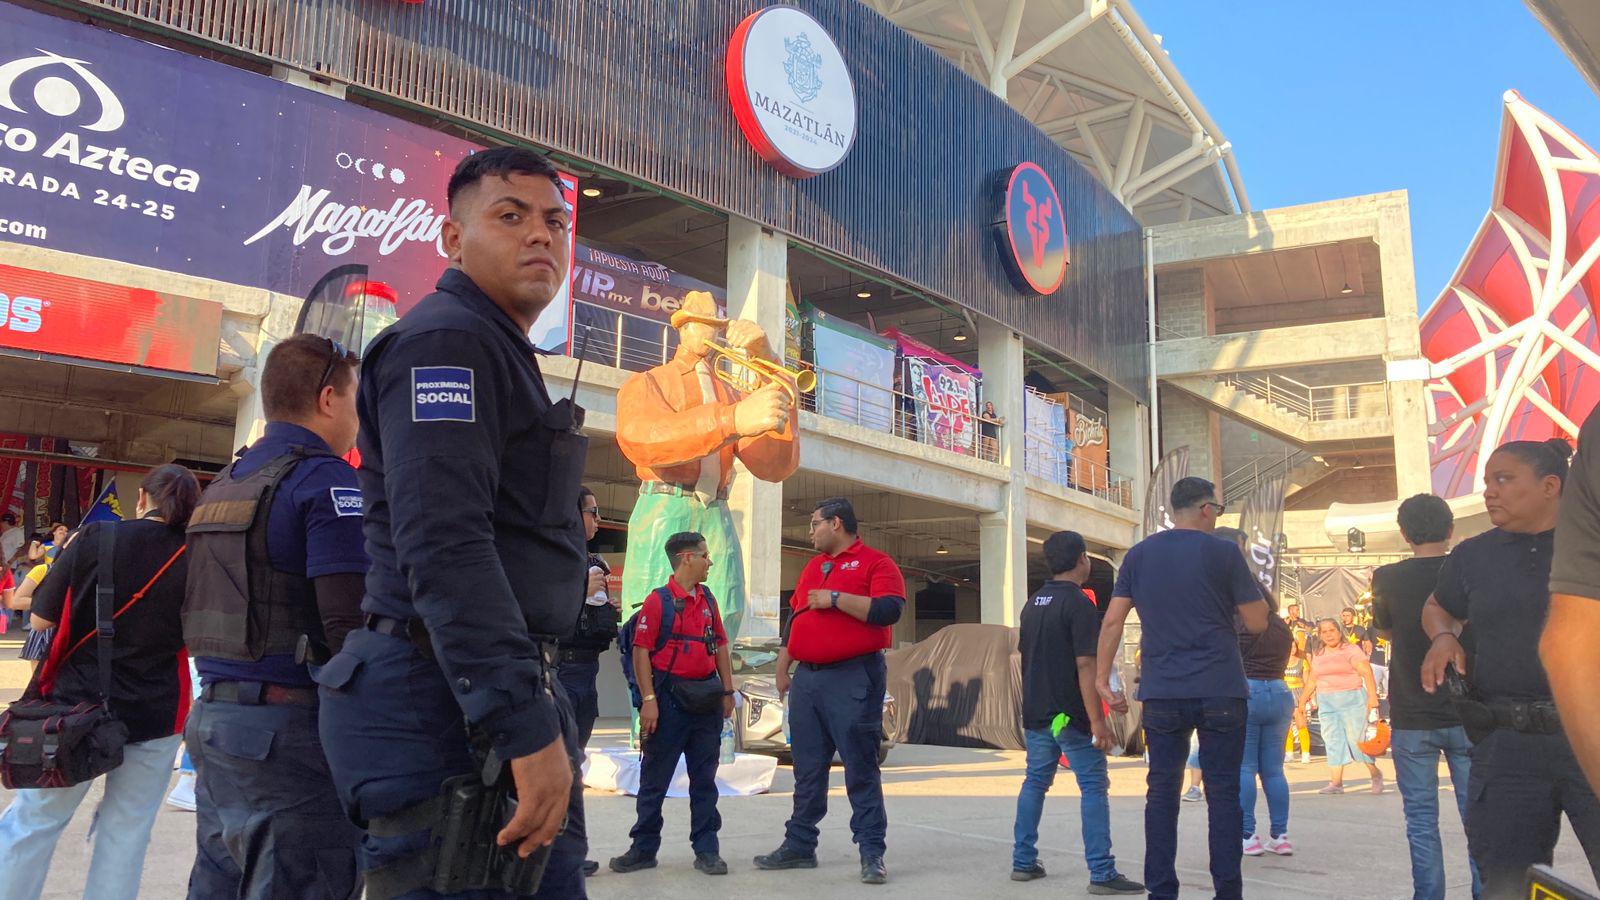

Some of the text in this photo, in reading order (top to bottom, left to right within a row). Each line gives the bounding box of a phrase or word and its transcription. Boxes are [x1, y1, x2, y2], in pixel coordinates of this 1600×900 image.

[755, 91, 846, 149] MAZATLÁN
[42, 132, 200, 192] Azteca
[93, 189, 176, 221] 24-25
[588, 248, 639, 275] ¡APUESTA
[416, 381, 471, 390] PROXIMIDAD
[416, 391, 472, 405] SOCIAL
